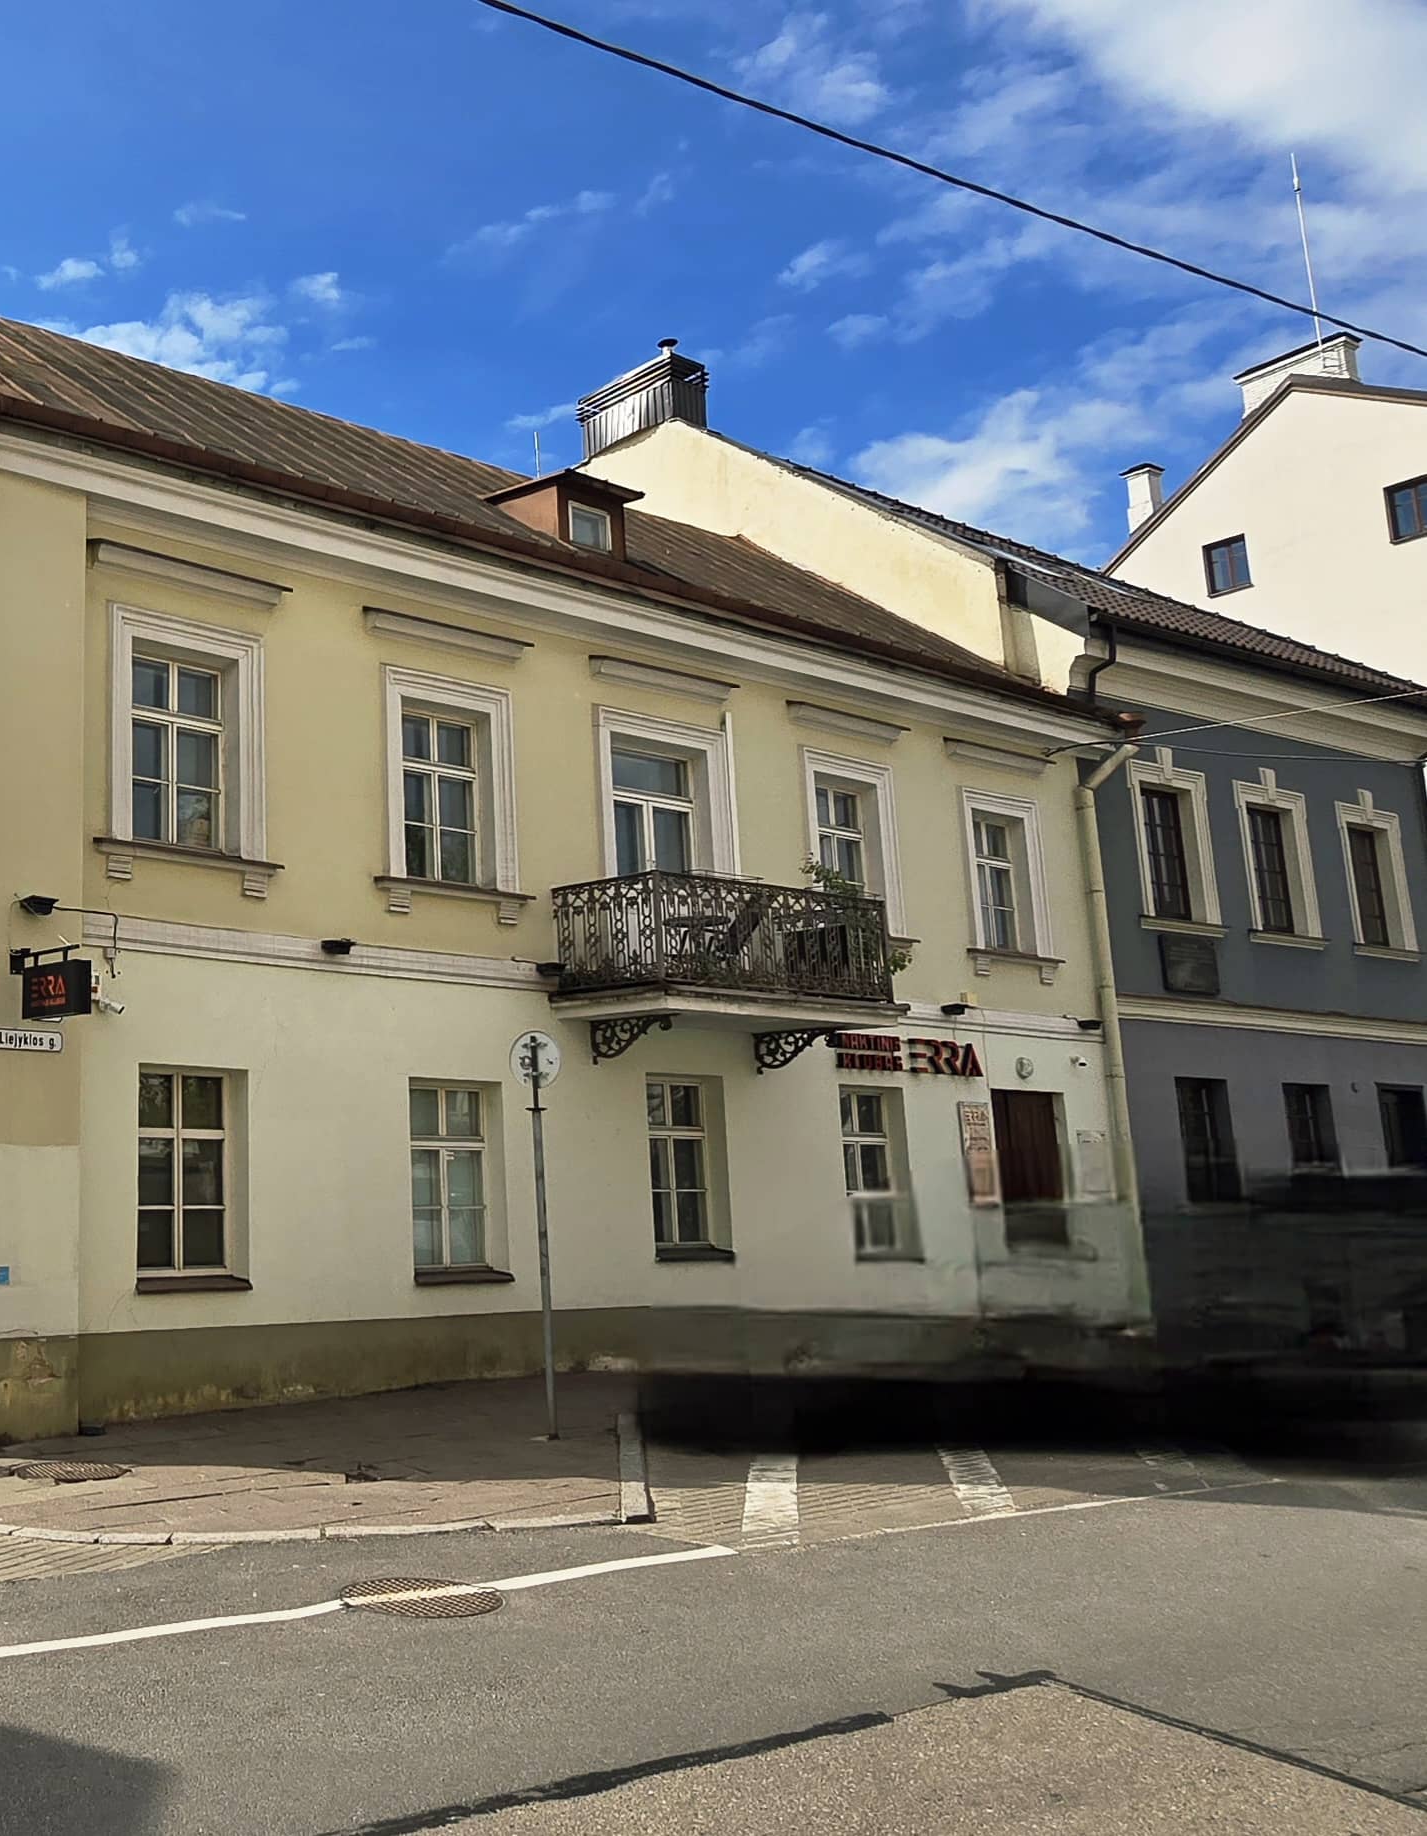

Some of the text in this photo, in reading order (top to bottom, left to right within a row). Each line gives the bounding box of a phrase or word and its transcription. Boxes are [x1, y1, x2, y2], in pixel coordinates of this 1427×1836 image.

[30, 975, 66, 996] ERRA
[0, 1031, 44, 1048] Liejyklos
[907, 1038, 984, 1077] ERRA
